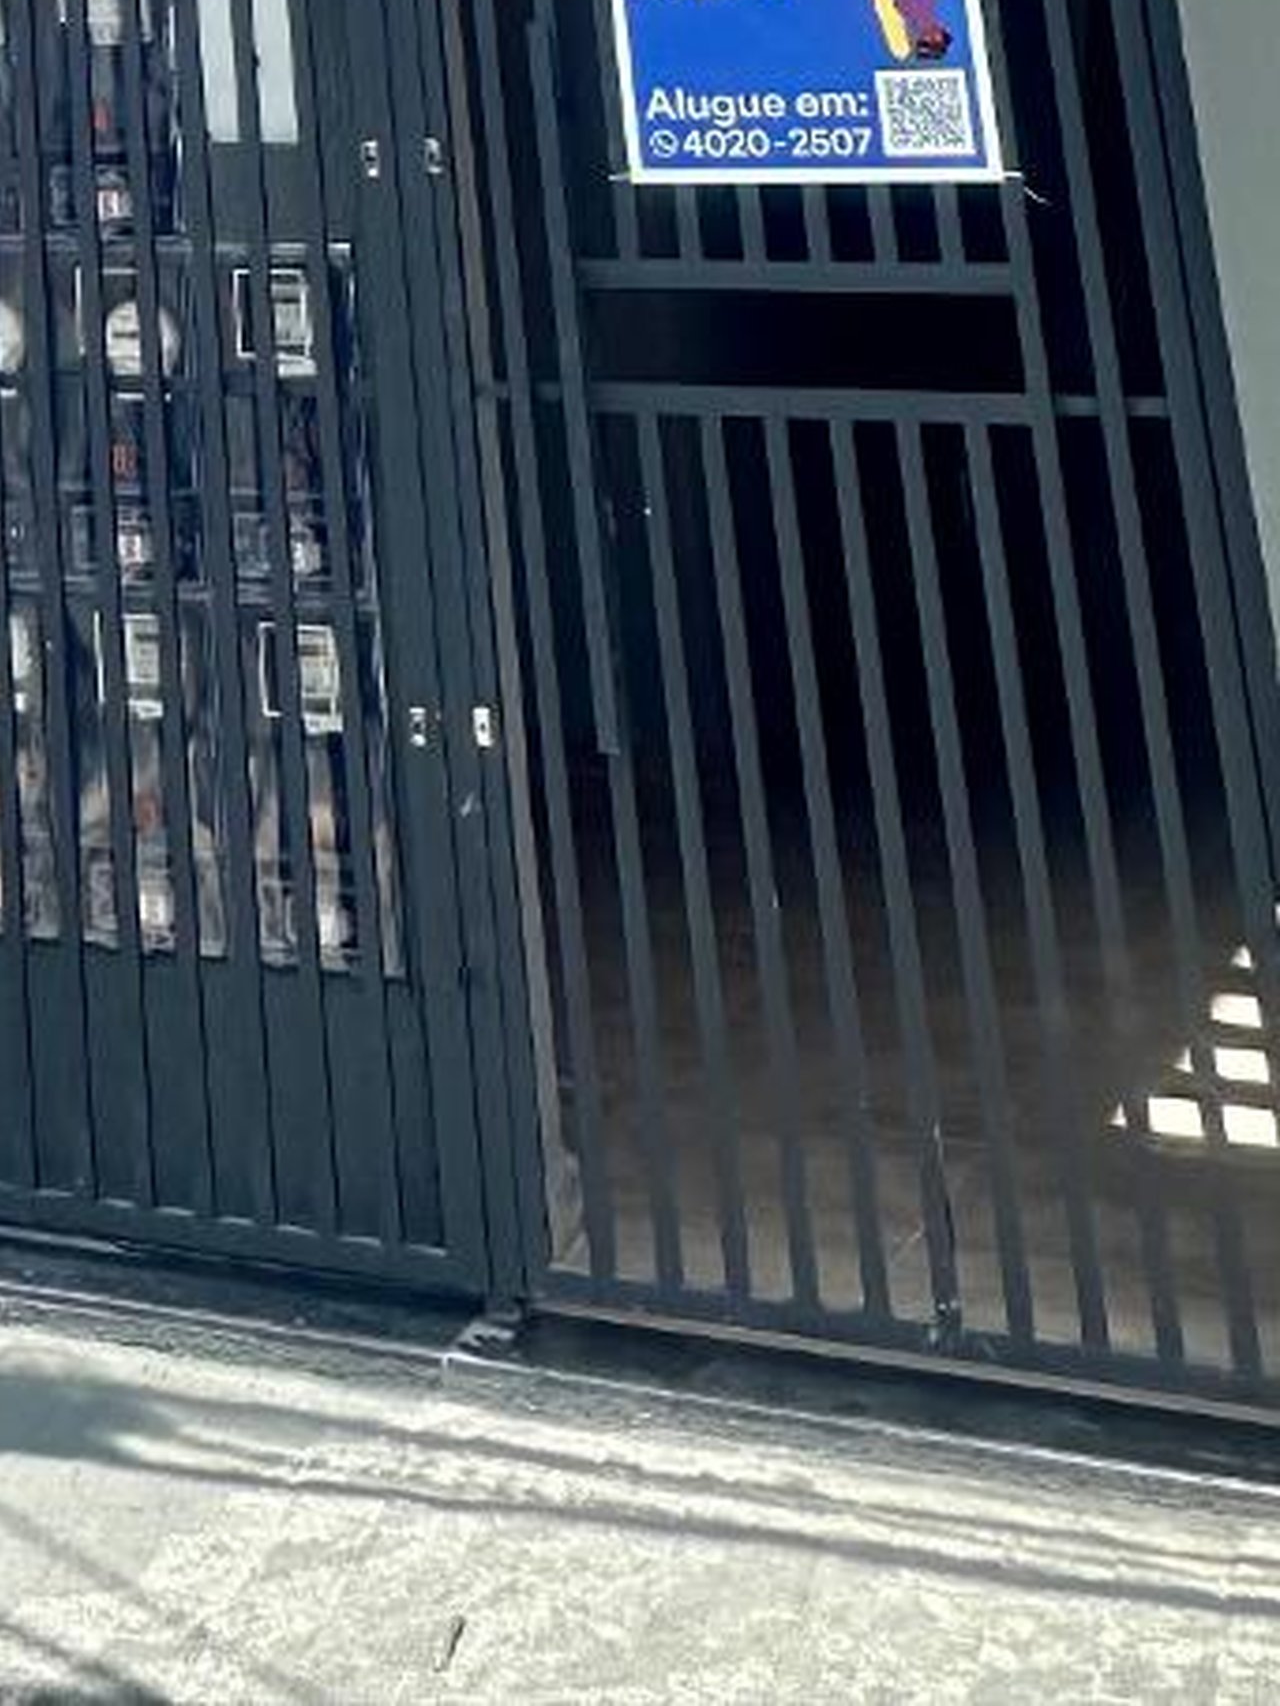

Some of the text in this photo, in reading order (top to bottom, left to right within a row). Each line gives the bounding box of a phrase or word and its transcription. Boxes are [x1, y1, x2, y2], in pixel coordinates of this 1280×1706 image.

[646, 87, 868, 127] Alugue em:
[682, 126, 873, 159] 4020-2507
